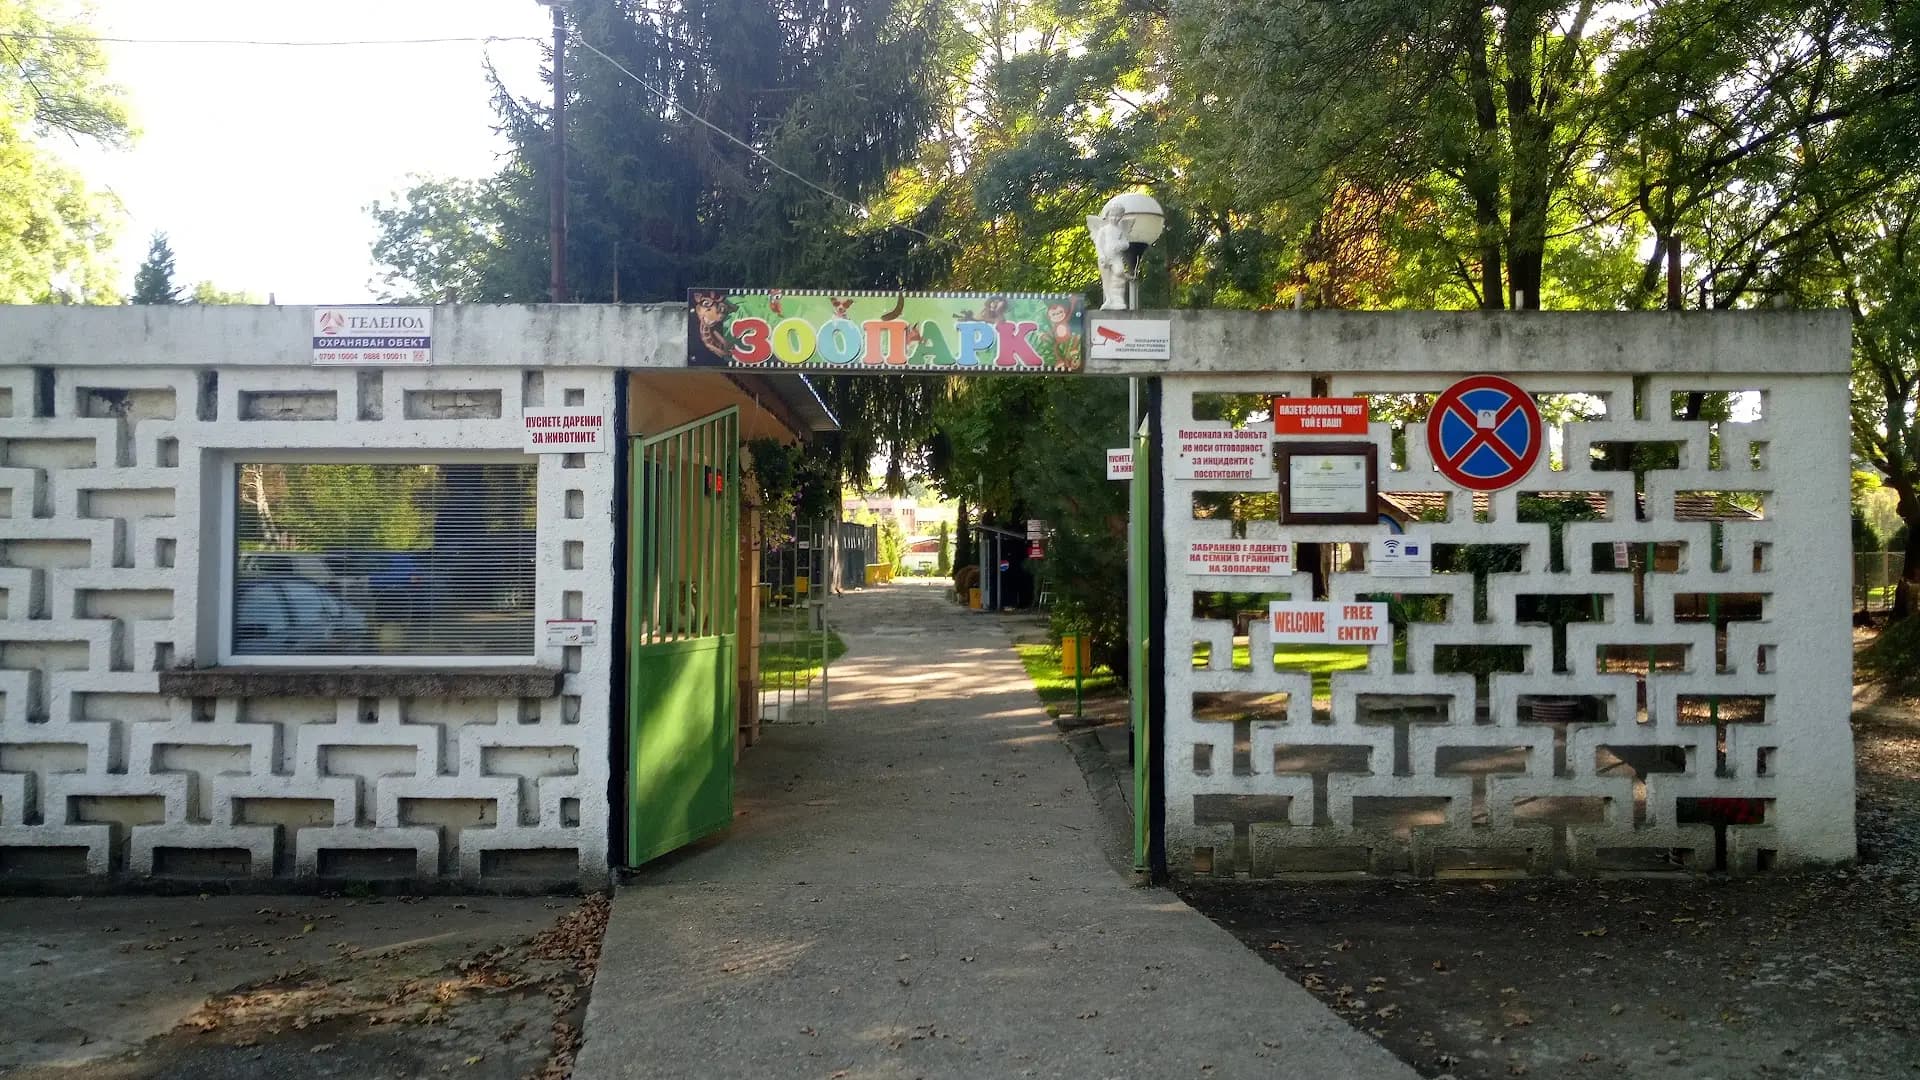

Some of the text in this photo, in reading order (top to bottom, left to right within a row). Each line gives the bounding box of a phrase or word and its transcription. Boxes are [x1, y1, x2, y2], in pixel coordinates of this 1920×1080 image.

[348, 316, 424, 329] ТЕЛЕПОЛ
[318, 338, 425, 347] ОХРАНЯВАН ОБЕКТ
[731, 317, 1043, 366] ЗООПАРК
[1280, 405, 1362, 415] ПАЗЕТЕ ЗООКЪТА ЧИСТ
[526, 415, 602, 429] ПУСНЕТЕ ДАРЕНИЯ
[1301, 416, 1316, 428] ТОЙ
[532, 432, 596, 443] ЗА ЖИВОТНИТЕ
[1179, 430, 1267, 440] Персонала на Зоокъта
[1183, 444, 1193, 452] не
[1194, 444, 1213, 452] носи
[1192, 457, 1202, 465] за
[1203, 457, 1247, 466] инциденти
[1194, 469, 1253, 478] посетителите!
[1191, 543, 1241, 552] ЗАБРАНЕНО
[1249, 544, 1287, 552] ЯДЕНЕТО
[1190, 554, 1201, 562] НА
[1203, 554, 1233, 562] СЕМКИ
[1241, 554, 1289, 563] ГРАНИЦИТЕ
[1222, 565, 1270, 573] ЗООПАРКА!
[1343, 605, 1373, 620] FREE
[1274, 612, 1325, 633] WELCOME
[1338, 626, 1379, 640] ENTRY
